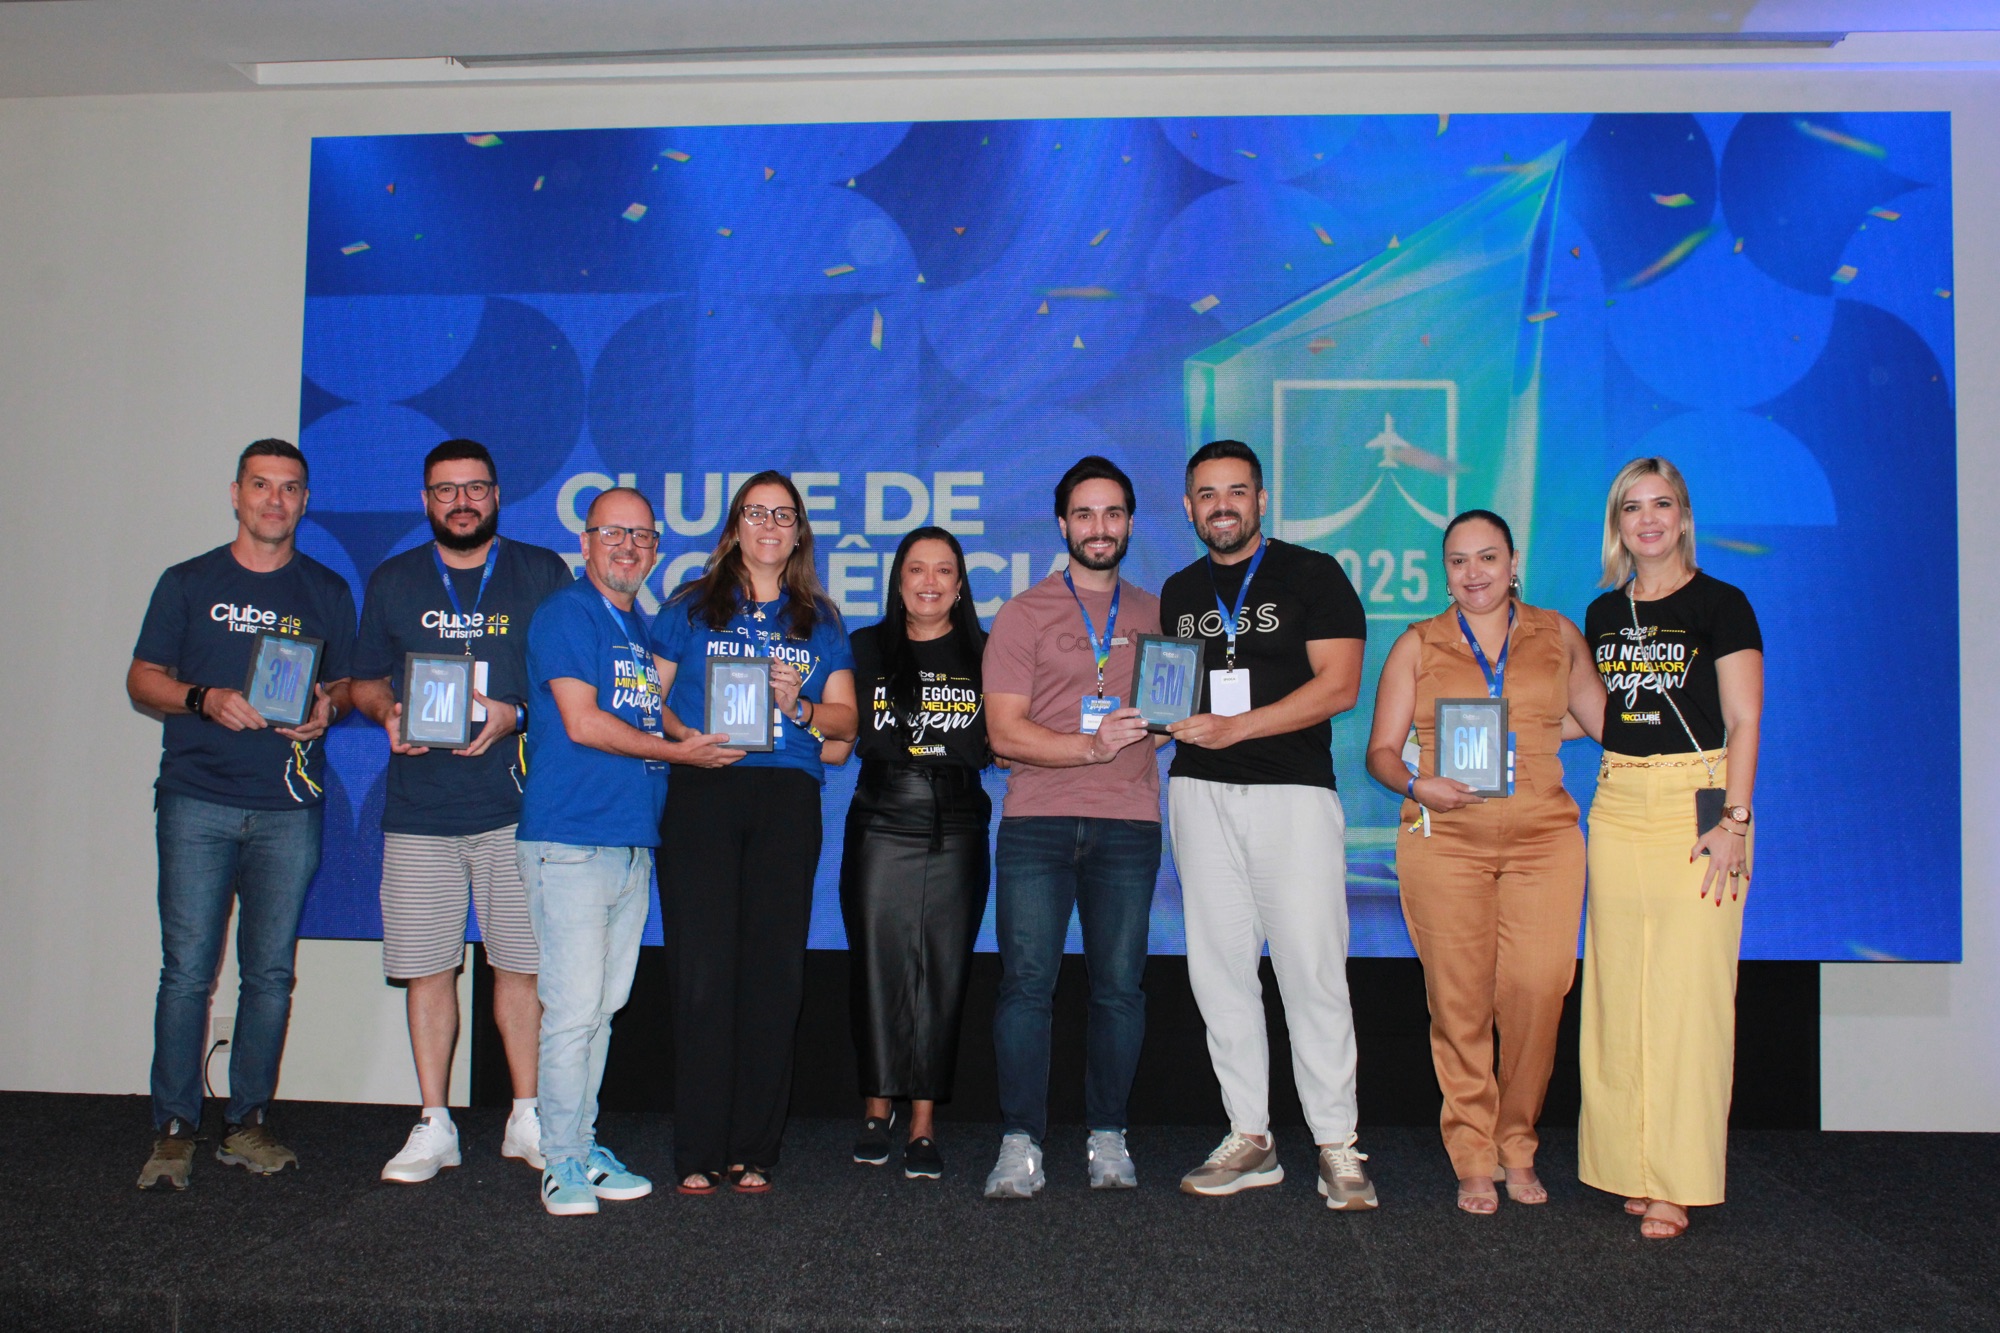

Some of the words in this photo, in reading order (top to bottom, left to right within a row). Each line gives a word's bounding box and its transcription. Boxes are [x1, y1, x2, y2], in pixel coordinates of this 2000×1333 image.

[864, 471, 985, 536] DE
[1335, 549, 1429, 603] 025
[210, 603, 277, 626] Clube
[228, 620, 276, 634] Turis
[421, 610, 485, 629] Clube
[1177, 603, 1279, 638] BOSS
[438, 627, 484, 638] Turismo
[706, 641, 740, 656] MEU
[744, 643, 810, 664] NGÓCIO
[1596, 643, 1616, 663] EU
[264, 658, 303, 703] 3M
[922, 684, 976, 703] EGÓCIO
[1151, 663, 1186, 706] 5M
[421, 680, 456, 723] 2M
[723, 683, 756, 726] 3M
[920, 701, 976, 713] MELHOR
[1453, 726, 1488, 770] 6M
